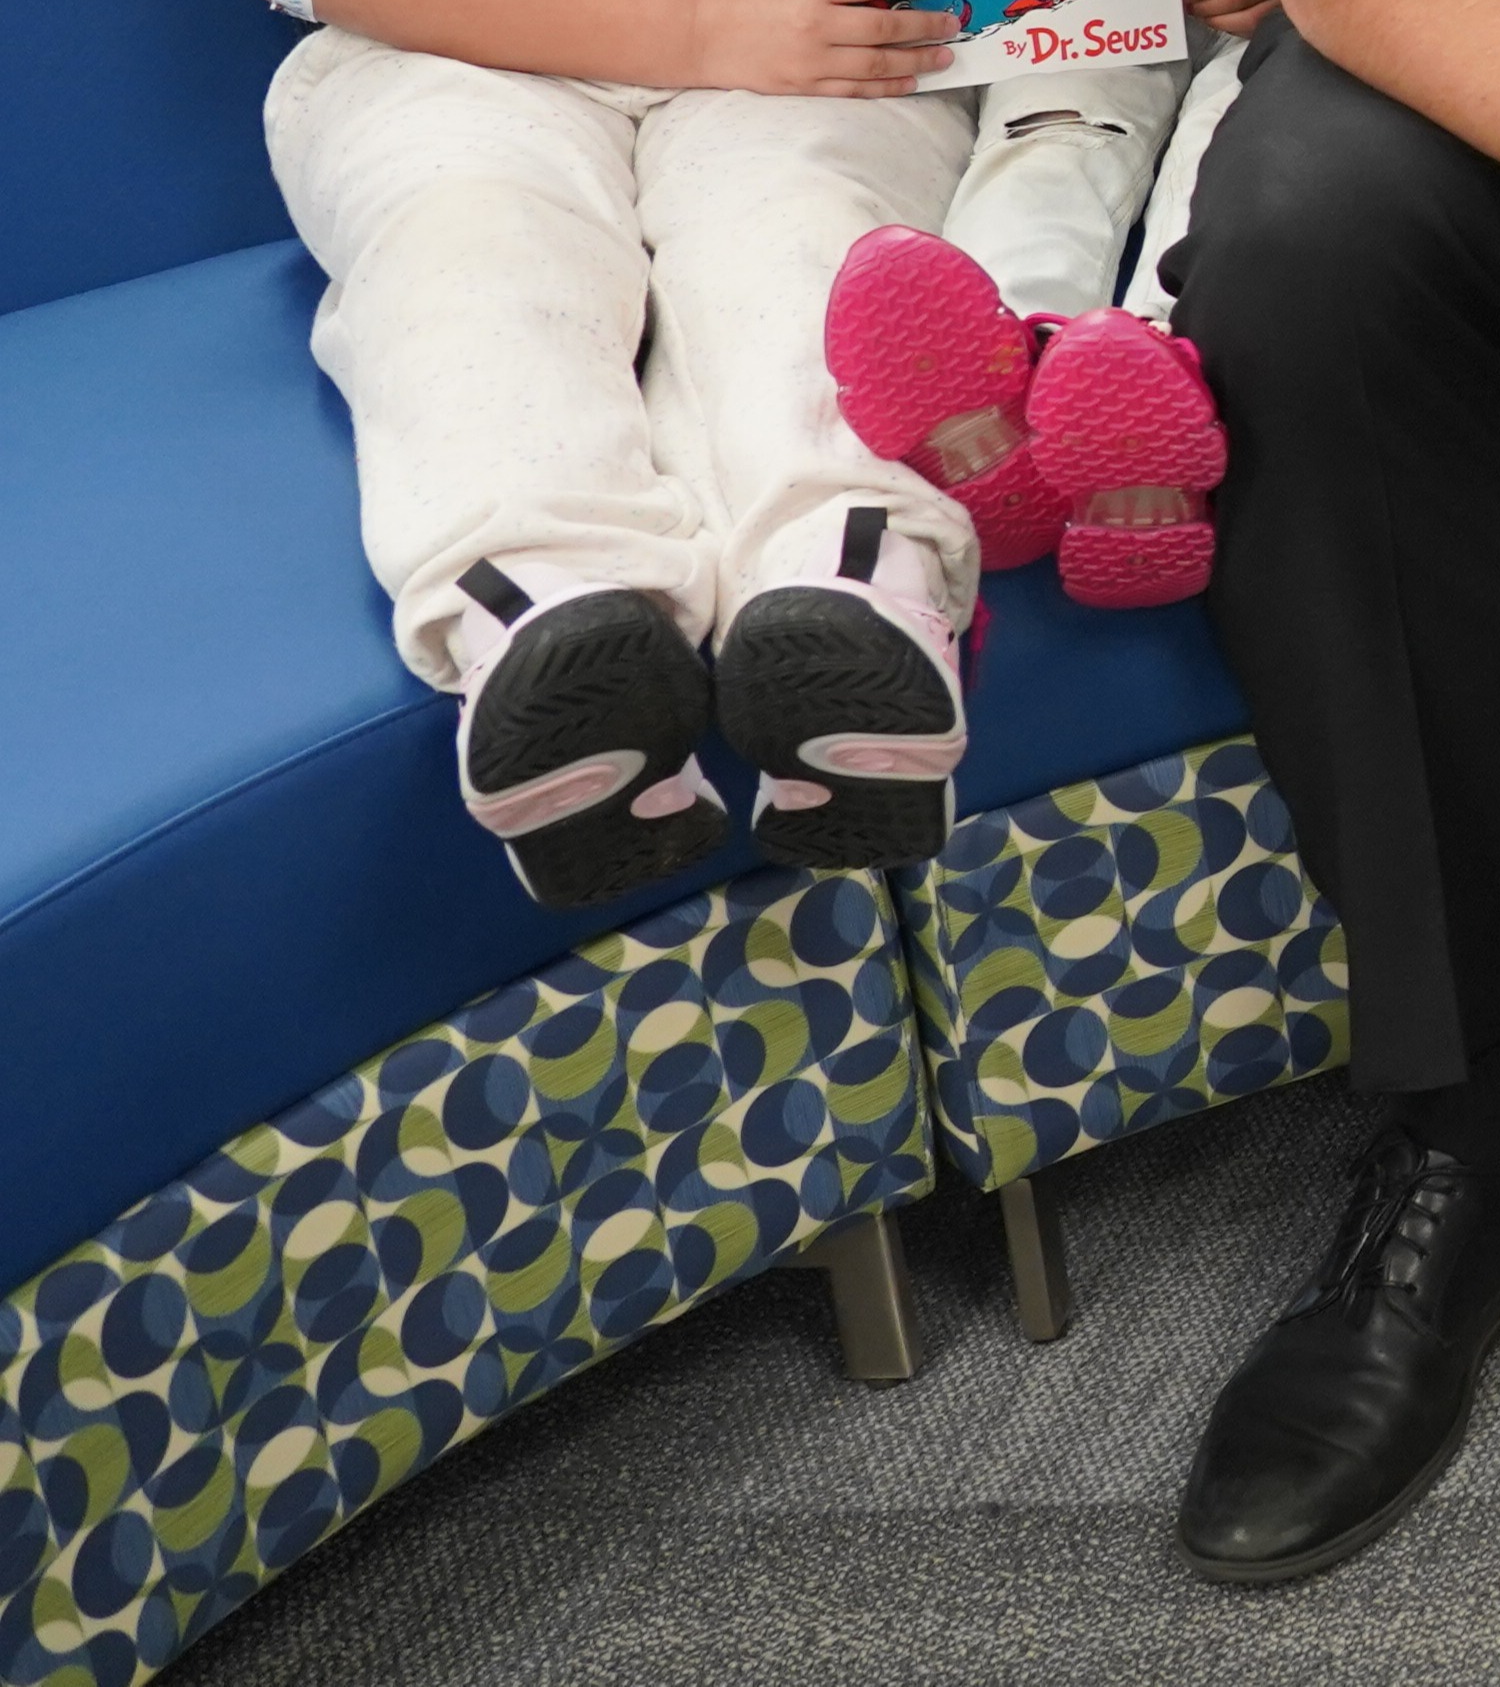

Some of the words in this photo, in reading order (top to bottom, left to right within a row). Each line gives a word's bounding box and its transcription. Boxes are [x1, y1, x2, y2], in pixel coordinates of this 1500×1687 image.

[1003, 40, 1027, 60] By
[1026, 26, 1079, 64] Dr.
[1083, 19, 1168, 57] Seuss
